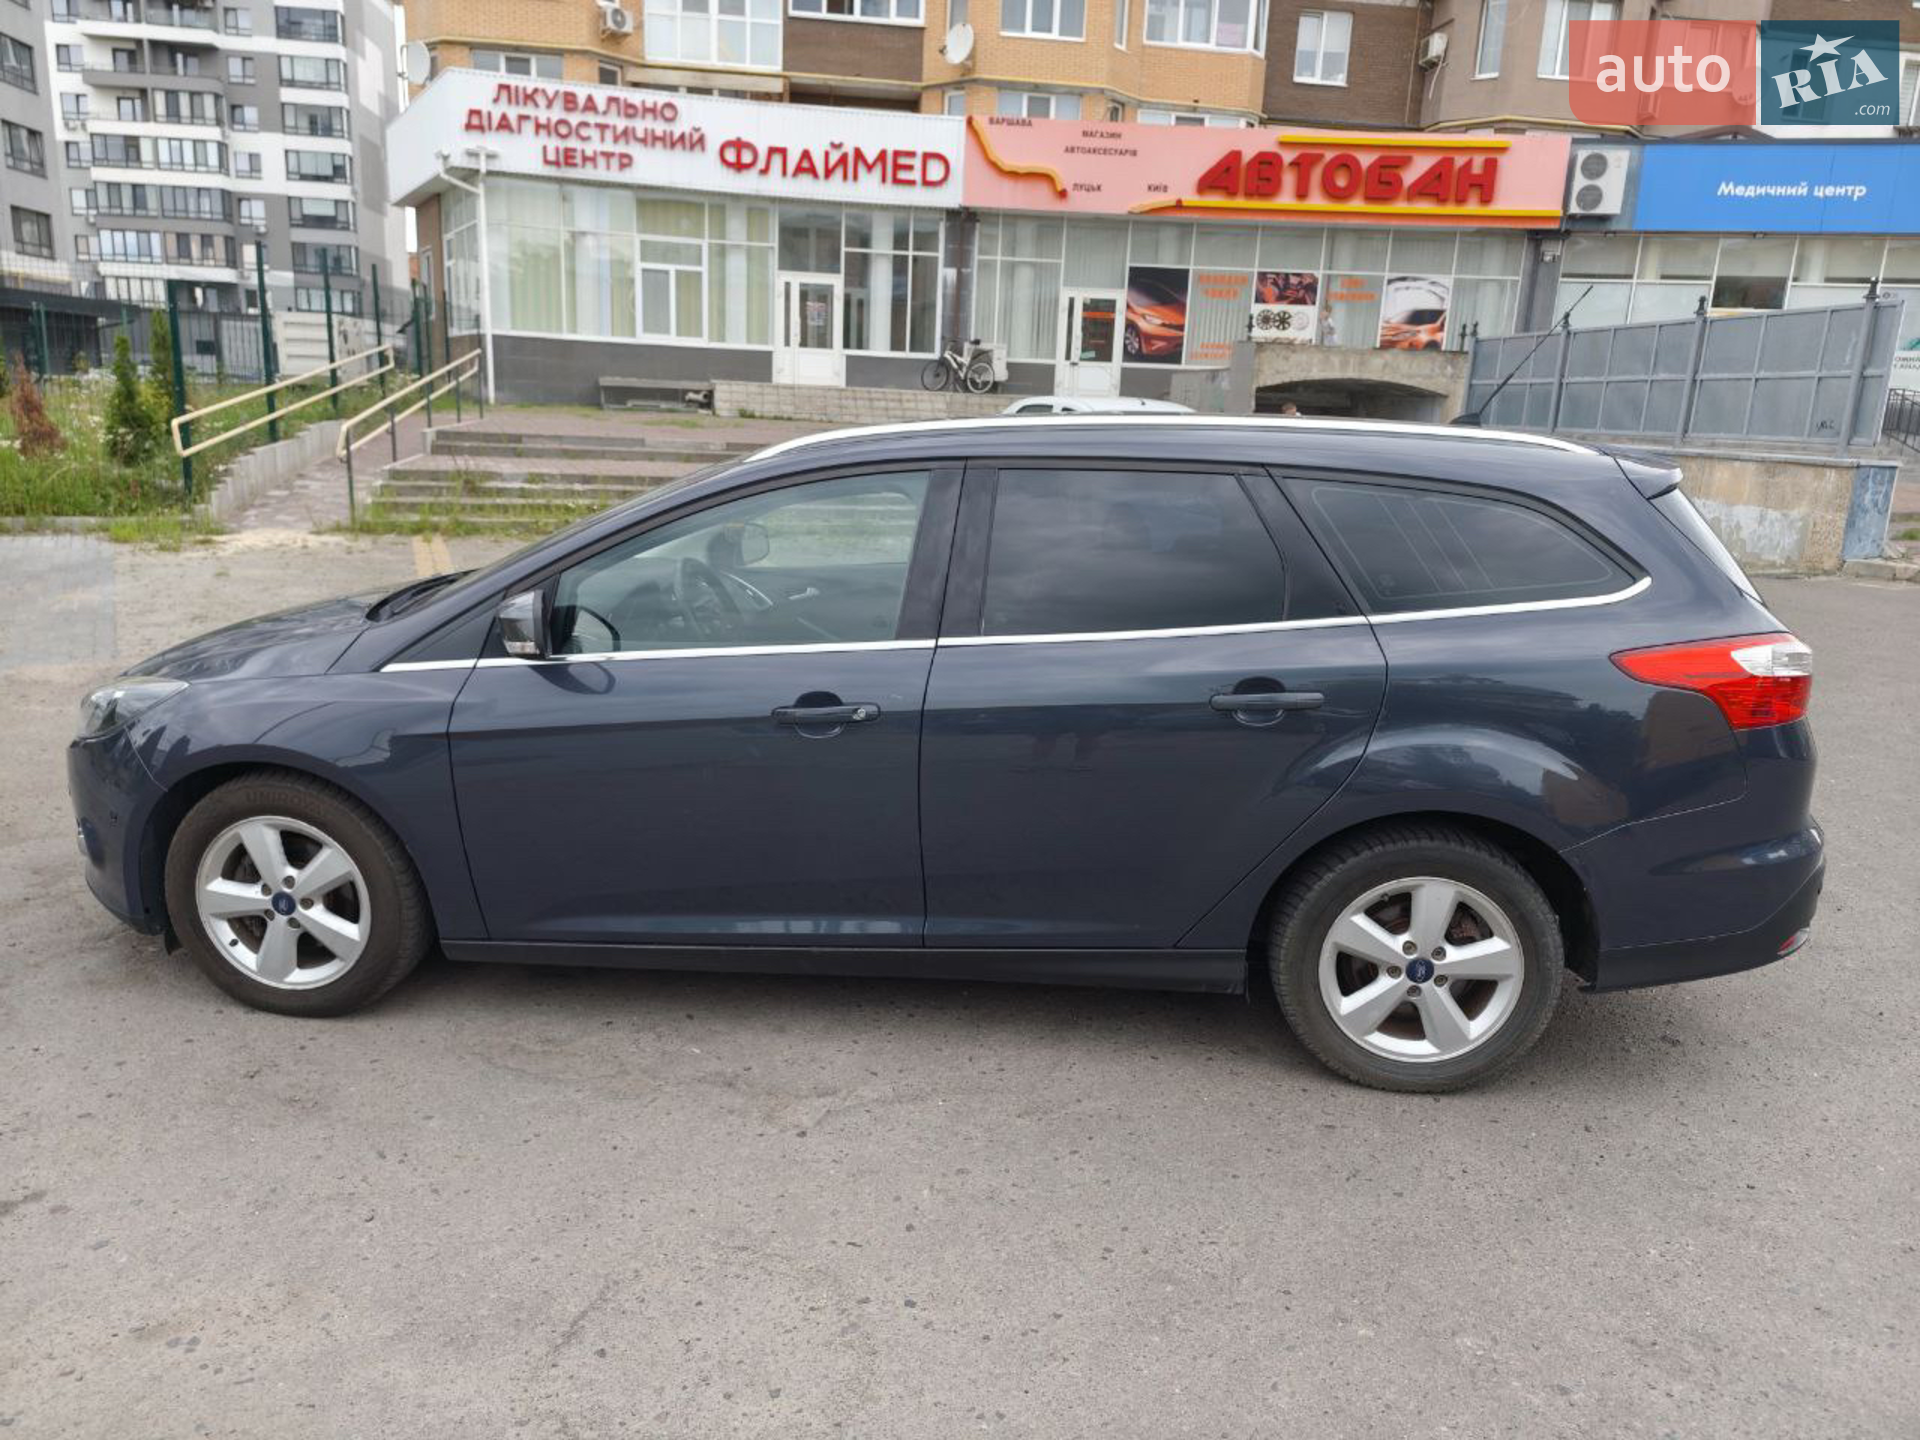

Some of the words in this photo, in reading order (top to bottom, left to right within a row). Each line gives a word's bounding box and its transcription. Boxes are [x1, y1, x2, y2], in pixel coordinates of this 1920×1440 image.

[493, 84, 679, 122] ЛІКУВАЛЬНО
[988, 117, 1033, 127] ВАРШАВА
[464, 109, 706, 152] ДІАГНОСТИЧНИЙ
[1082, 130, 1122, 139] МАГАЗИН
[542, 145, 634, 170] ЦЕНТР
[1063, 146, 1138, 157] АВТОАКСЕСУАРІВ
[1196, 149, 1499, 204] АВТОБАН
[1072, 183, 1102, 193] ЛУЦЬК
[1147, 184, 1169, 193] КИЇВ
[1717, 181, 1808, 197] Медичний
[1813, 185, 1867, 201] центр
